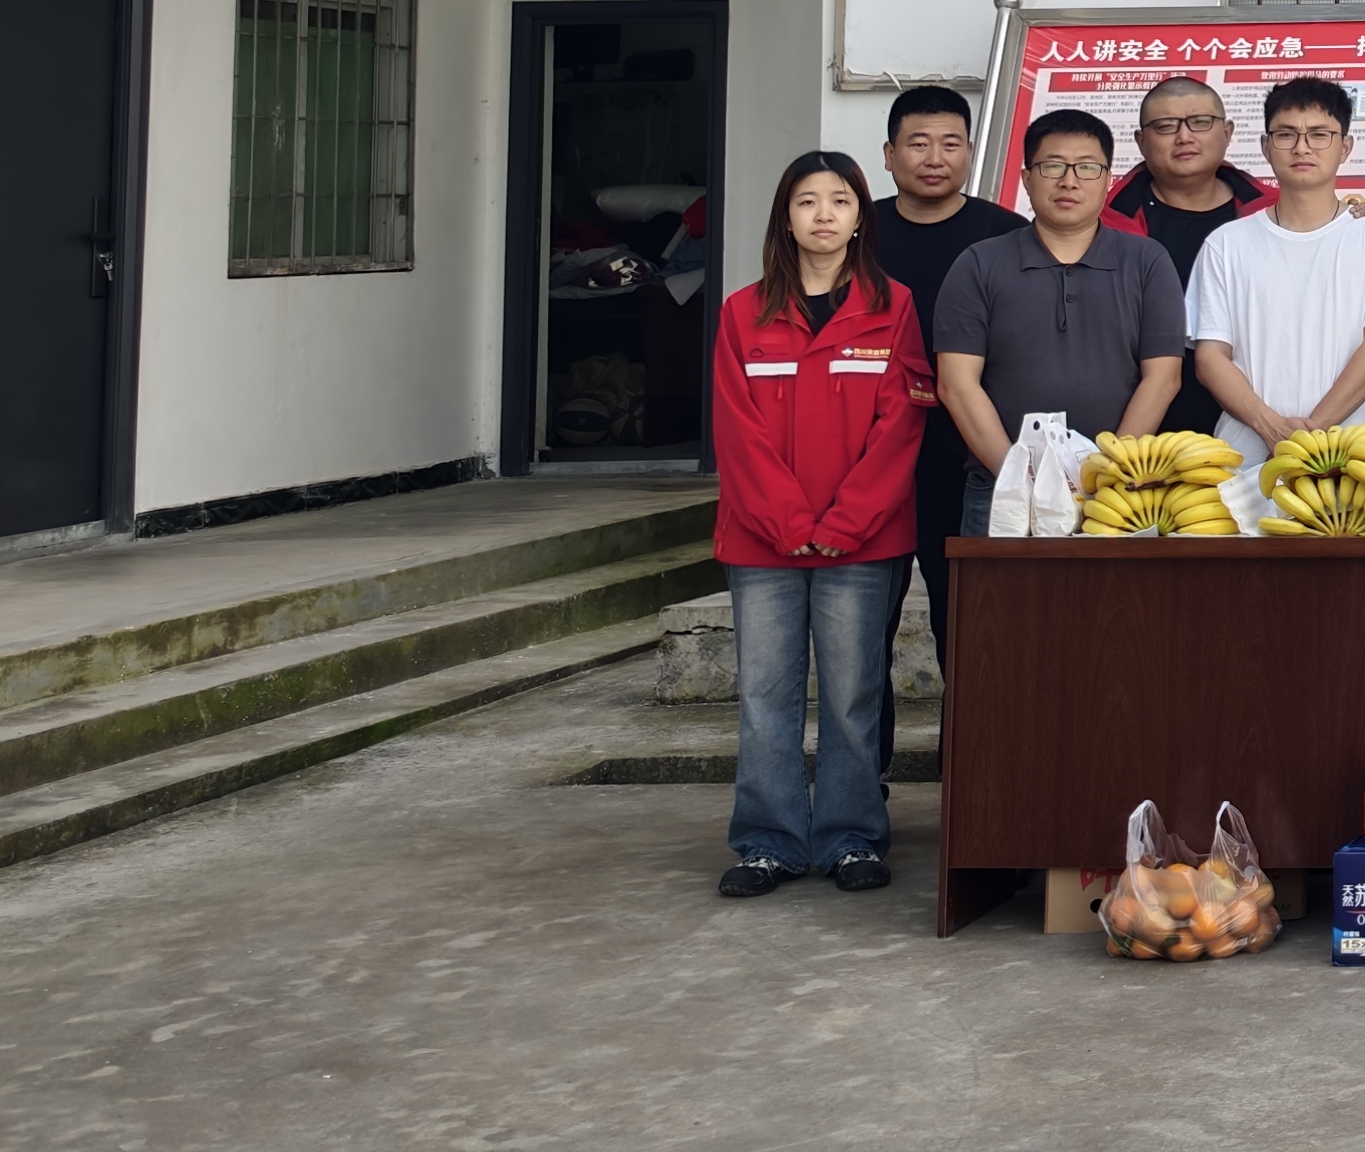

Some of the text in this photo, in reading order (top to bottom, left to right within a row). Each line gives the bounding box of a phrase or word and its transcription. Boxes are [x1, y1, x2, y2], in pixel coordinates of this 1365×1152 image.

[1041, 38, 1169, 62] 人人讲安全
